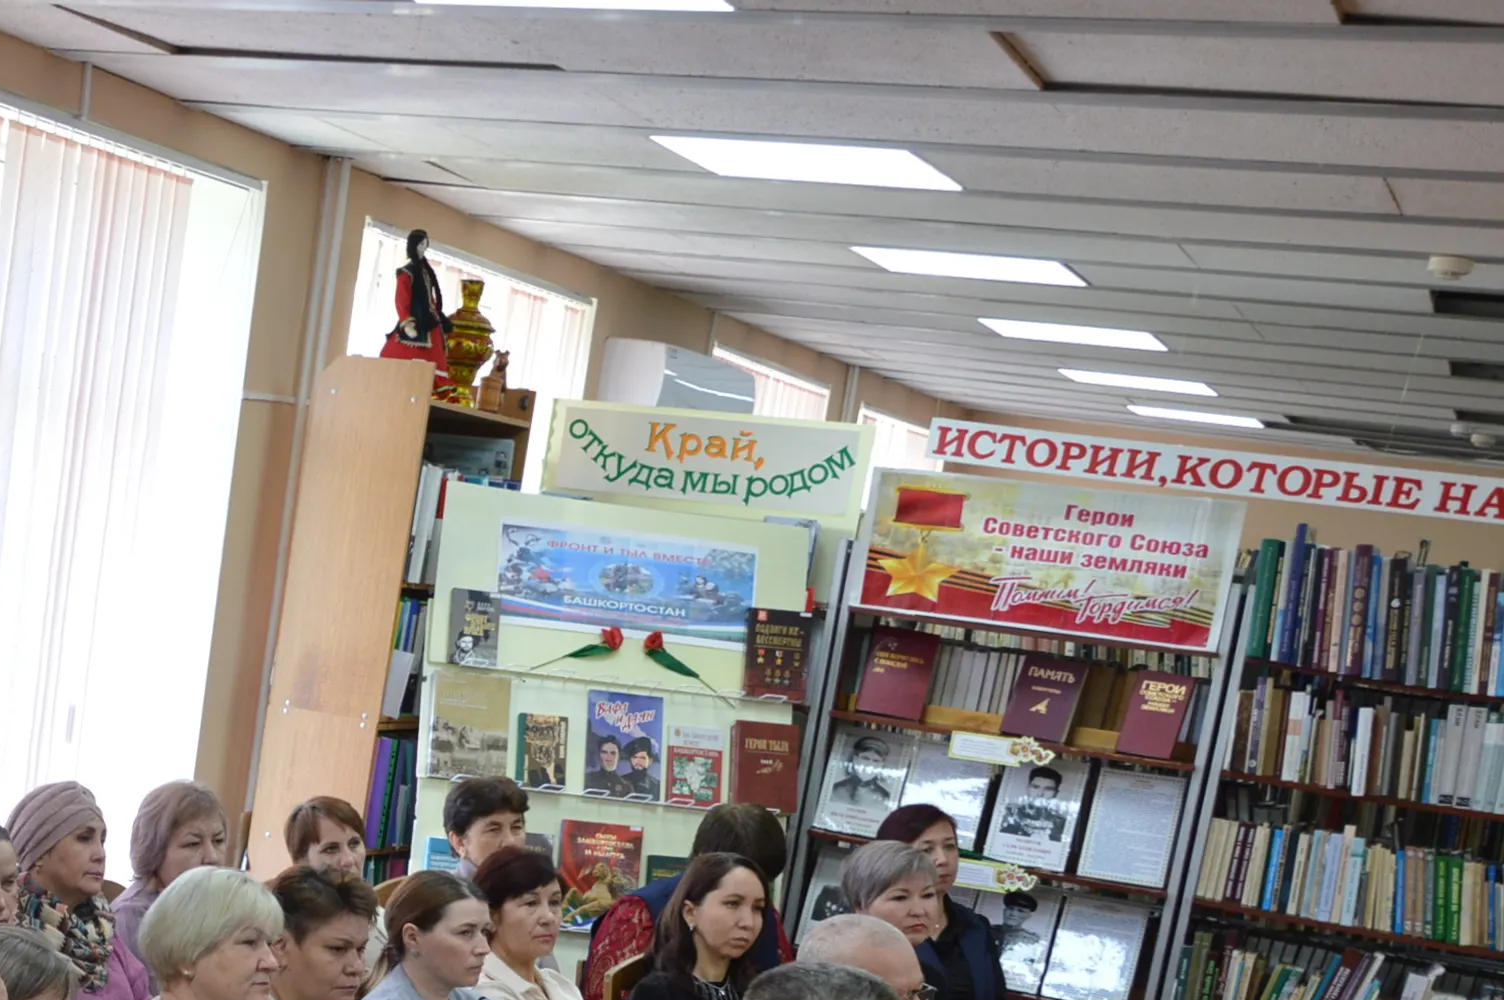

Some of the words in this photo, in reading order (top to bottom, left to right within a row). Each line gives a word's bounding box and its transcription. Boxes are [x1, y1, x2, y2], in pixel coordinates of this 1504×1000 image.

[646, 420, 765, 469] Край,
[569, 418, 674, 490] откуда
[680, 466, 738, 496] мы
[743, 446, 856, 505] родом
[1064, 504, 1135, 527] Герои
[547, 540, 599, 554] ФРОНТ
[604, 546, 614, 554] И
[620, 547, 648, 558] ТЫЛ
[983, 517, 1123, 548] Советского
[1130, 534, 1209, 558] Союза
[1010, 545, 1074, 564] наши
[1080, 553, 1188, 578] земляки
[563, 595, 687, 617] БАШКОРТОСТАН
[991, 576, 1096, 612] Помним!
[1073, 588, 1200, 625] Гордимся!
[1028, 666, 1076, 684] ПАМЯТЬ
[1141, 680, 1187, 695] ГЕРОИ
